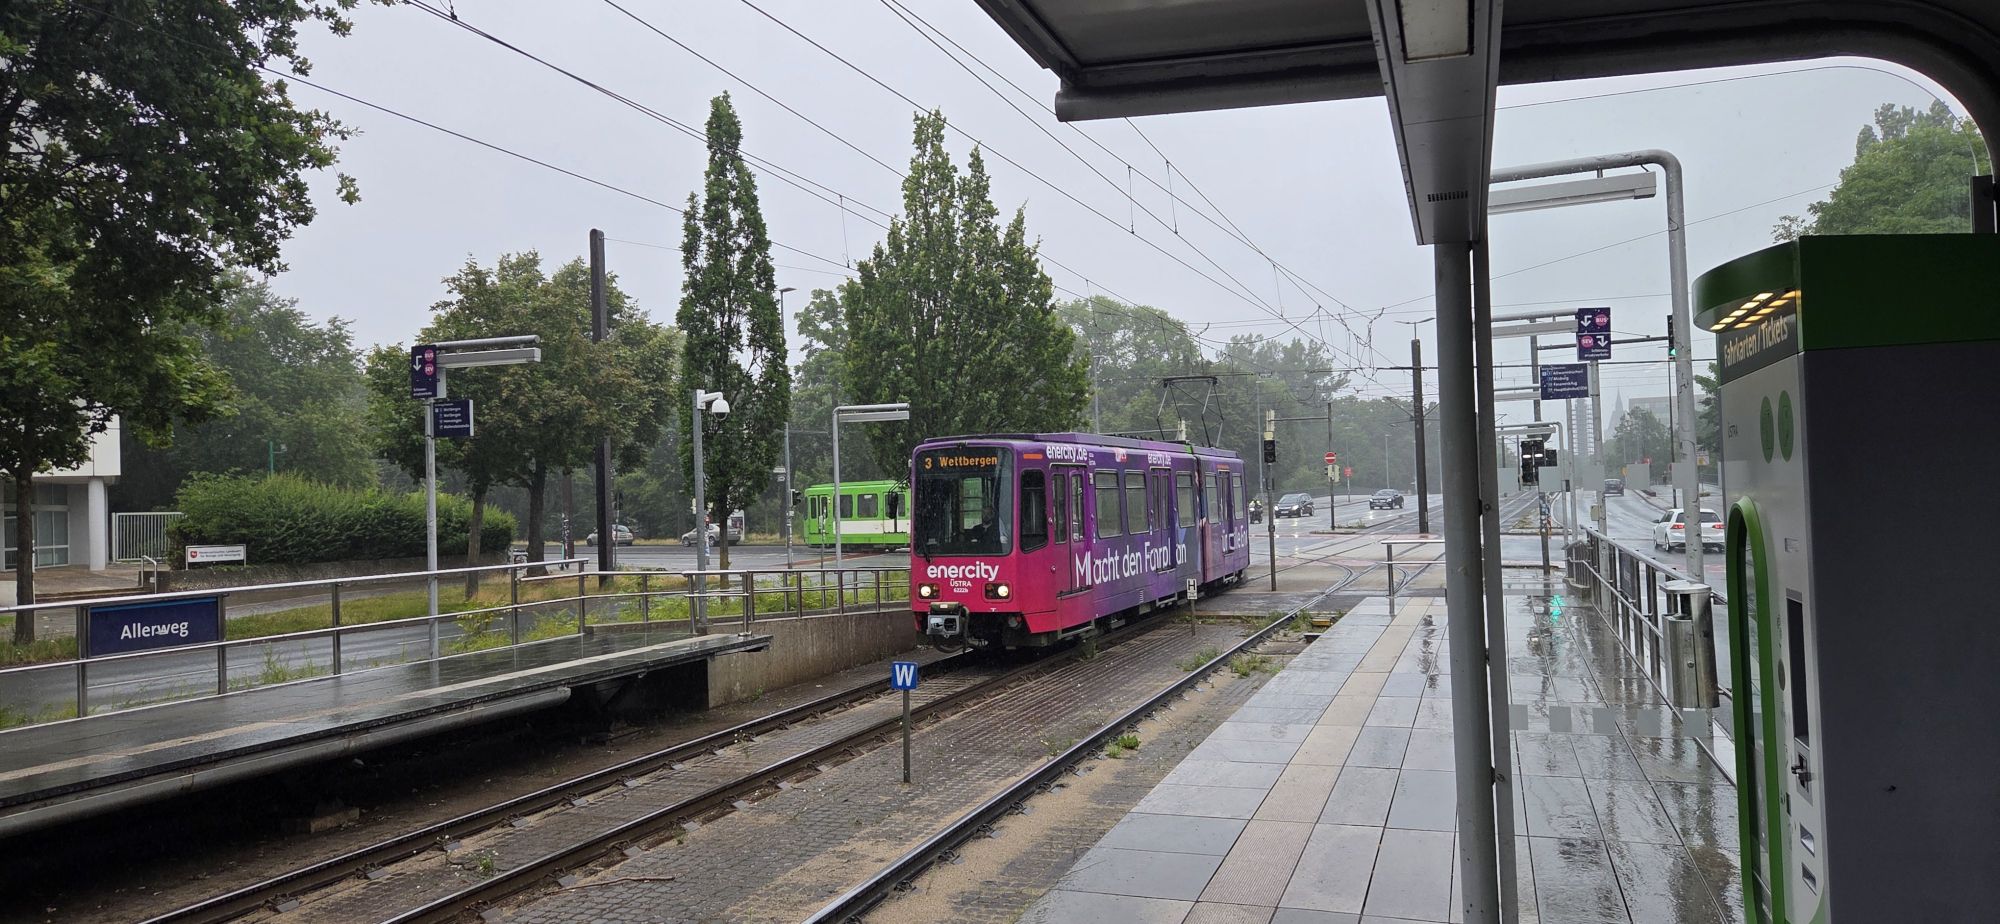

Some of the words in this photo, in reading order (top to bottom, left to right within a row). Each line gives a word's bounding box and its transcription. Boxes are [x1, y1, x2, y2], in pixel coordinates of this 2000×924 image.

[1723, 333, 1757, 368] Fahrkarten
[1761, 315, 1788, 350] Tickets
[925, 457, 932, 469] 3
[939, 455, 998, 468] Wettbergen
[1046, 445, 1088, 462] enercity.de
[1122, 544, 1143, 578] den
[926, 561, 999, 581] enercity
[949, 579, 972, 587] ÜSTRA
[1188, 580, 1196, 590] H
[120, 621, 189, 640] Allerweg
[895, 664, 915, 687] W
